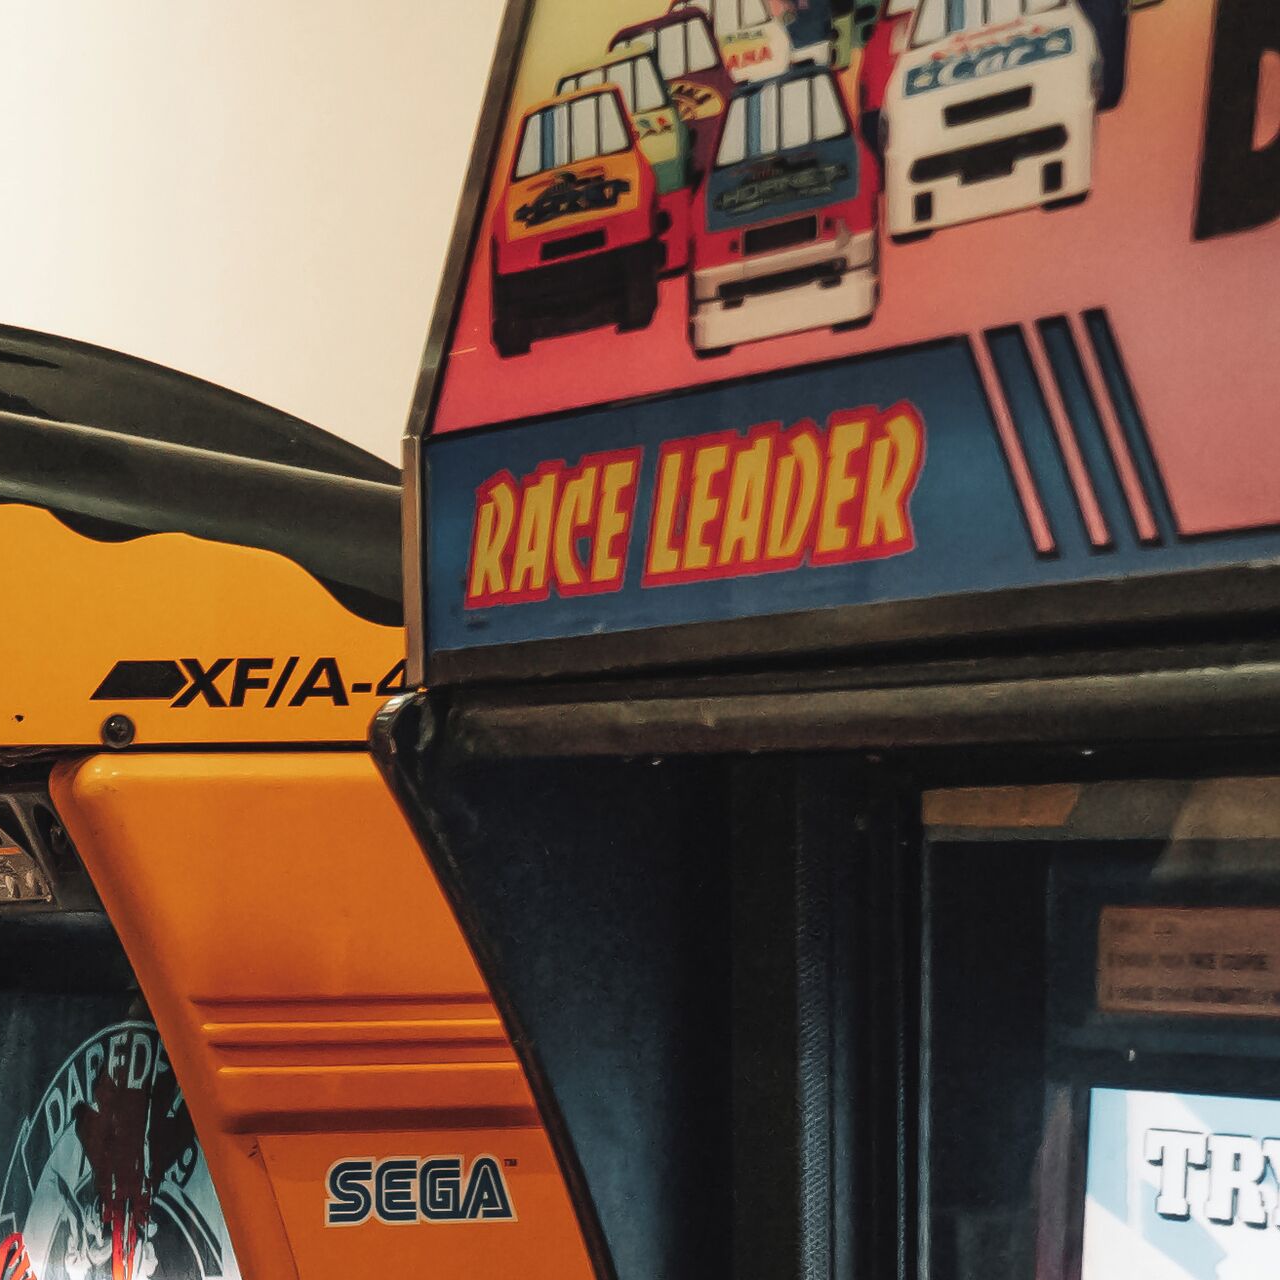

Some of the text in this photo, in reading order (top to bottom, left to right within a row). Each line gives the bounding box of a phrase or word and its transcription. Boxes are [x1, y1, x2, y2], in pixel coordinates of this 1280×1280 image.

[465, 400, 926, 609] RACE LEADER
[325, 1154, 518, 1227] SEGA
